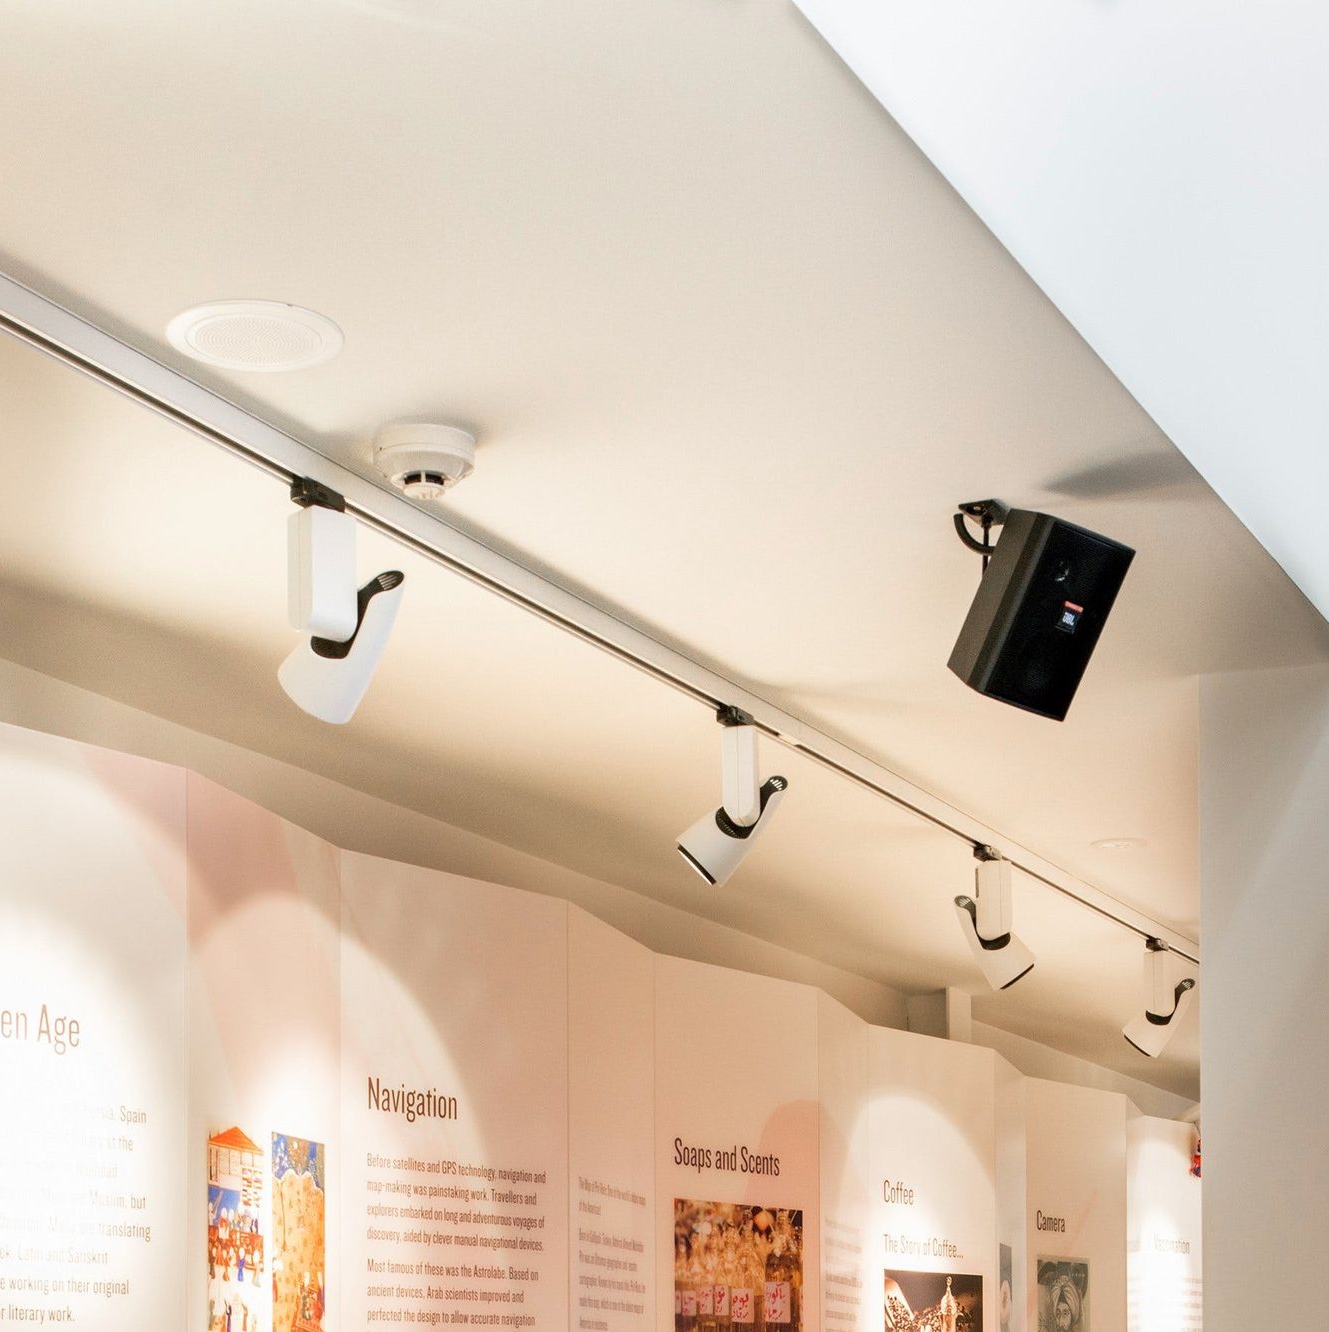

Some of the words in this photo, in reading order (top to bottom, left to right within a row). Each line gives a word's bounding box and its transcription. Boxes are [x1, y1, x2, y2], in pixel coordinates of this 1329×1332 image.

[38, 1004, 80, 1055] Age
[368, 1077, 457, 1122] Navigation
[119, 1106, 147, 1128] Spain
[118, 1137, 133, 1152] the
[675, 1138, 711, 1173] Soaps
[716, 1145, 736, 1171] and
[741, 1146, 780, 1176] Scents
[130, 1194, 146, 1209] but
[883, 1180, 913, 1205] Coffee
[98, 1222, 151, 1242] translating
[1037, 1210, 1065, 1232] Camera
[884, 1234, 897, 1253] The
[924, 1238, 931, 1255] of
[9, 1275, 48, 1295] working
[52, 1279, 64, 1291] on
[68, 1278, 90, 1294] their
[93, 1279, 129, 1298] original
[8, 1305, 44, 1324] literary
[48, 1307, 75, 1322] work.
[367, 1308, 401, 1323] perfected
[404, 1309, 415, 1321] the
[417, 1310, 440, 1326] design
[442, 1312, 449, 1323] to
[451, 1310, 469, 1323] allow
[471, 1314, 500, 1325] accurate
[502, 1314, 535, 1328] navigation
